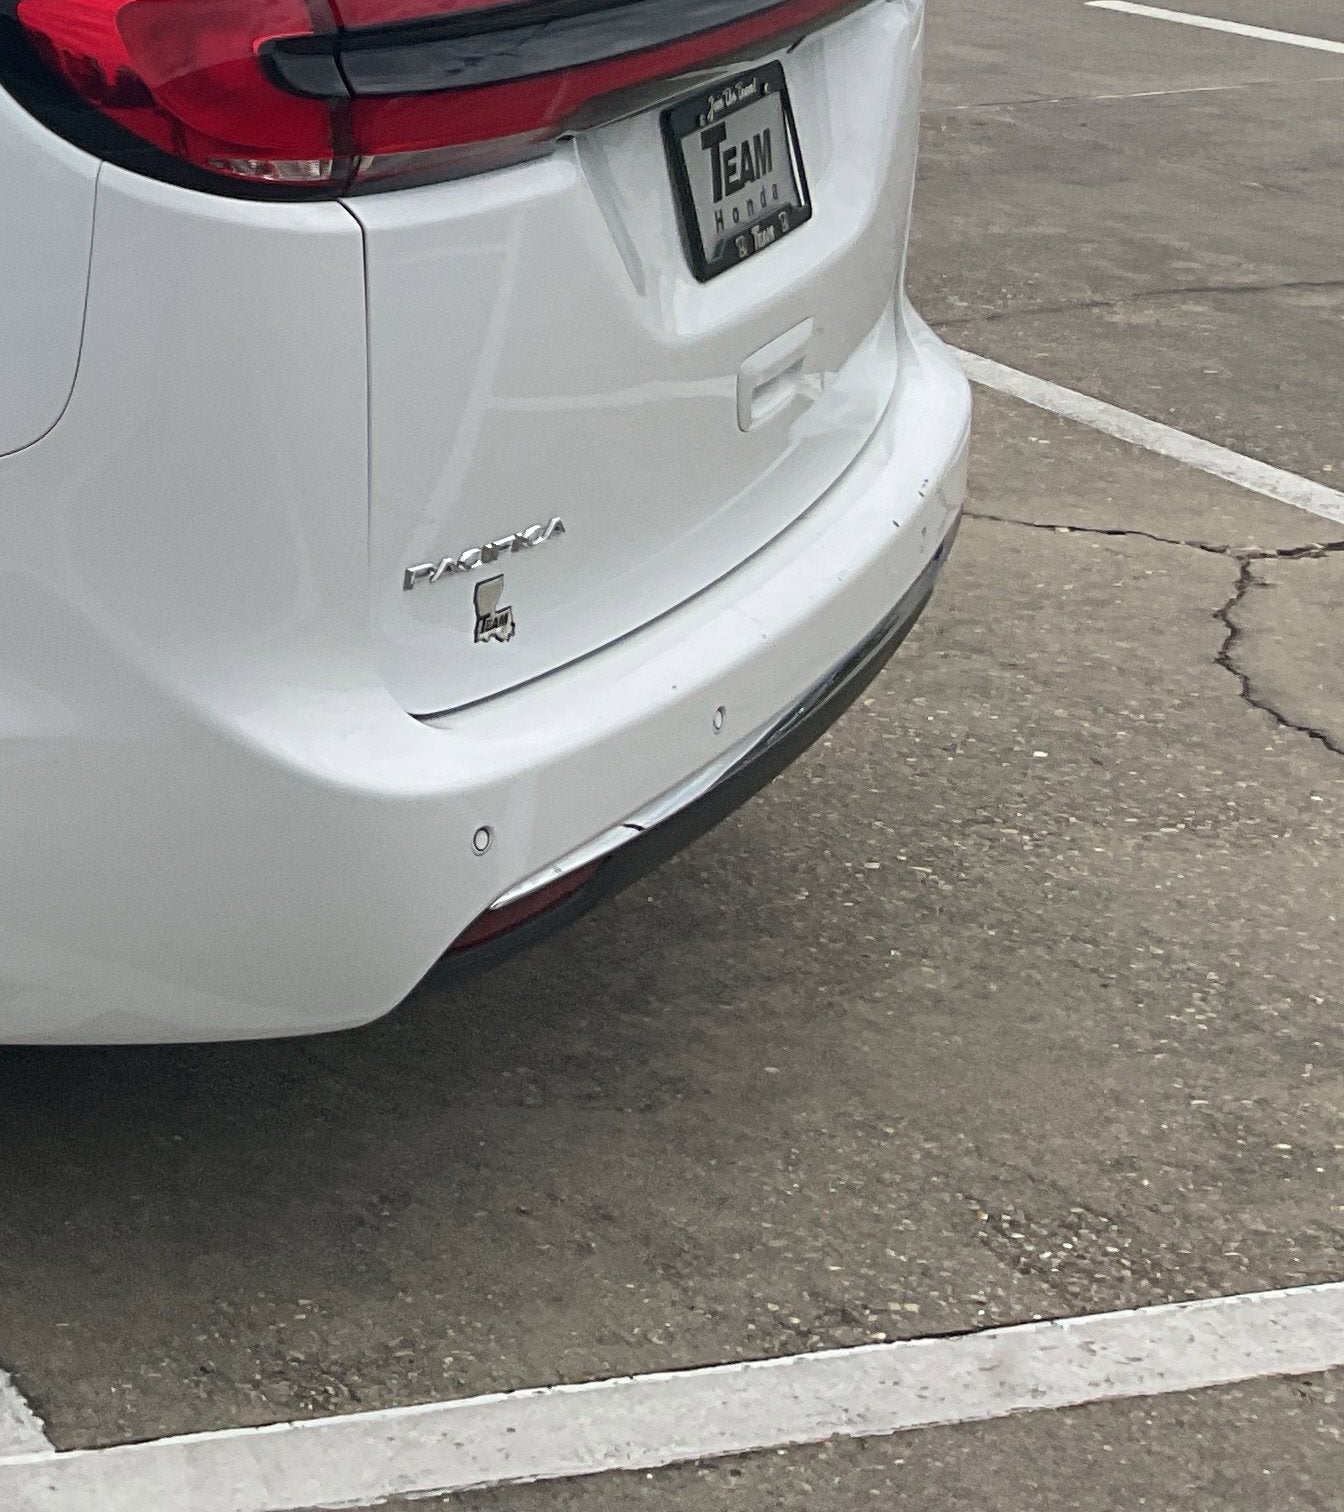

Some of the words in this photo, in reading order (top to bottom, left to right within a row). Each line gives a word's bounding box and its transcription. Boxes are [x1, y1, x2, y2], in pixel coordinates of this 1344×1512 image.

[700, 121, 772, 204] TEAM
[403, 517, 566, 591] PACIFICA
[478, 612, 509, 634] TEAM
